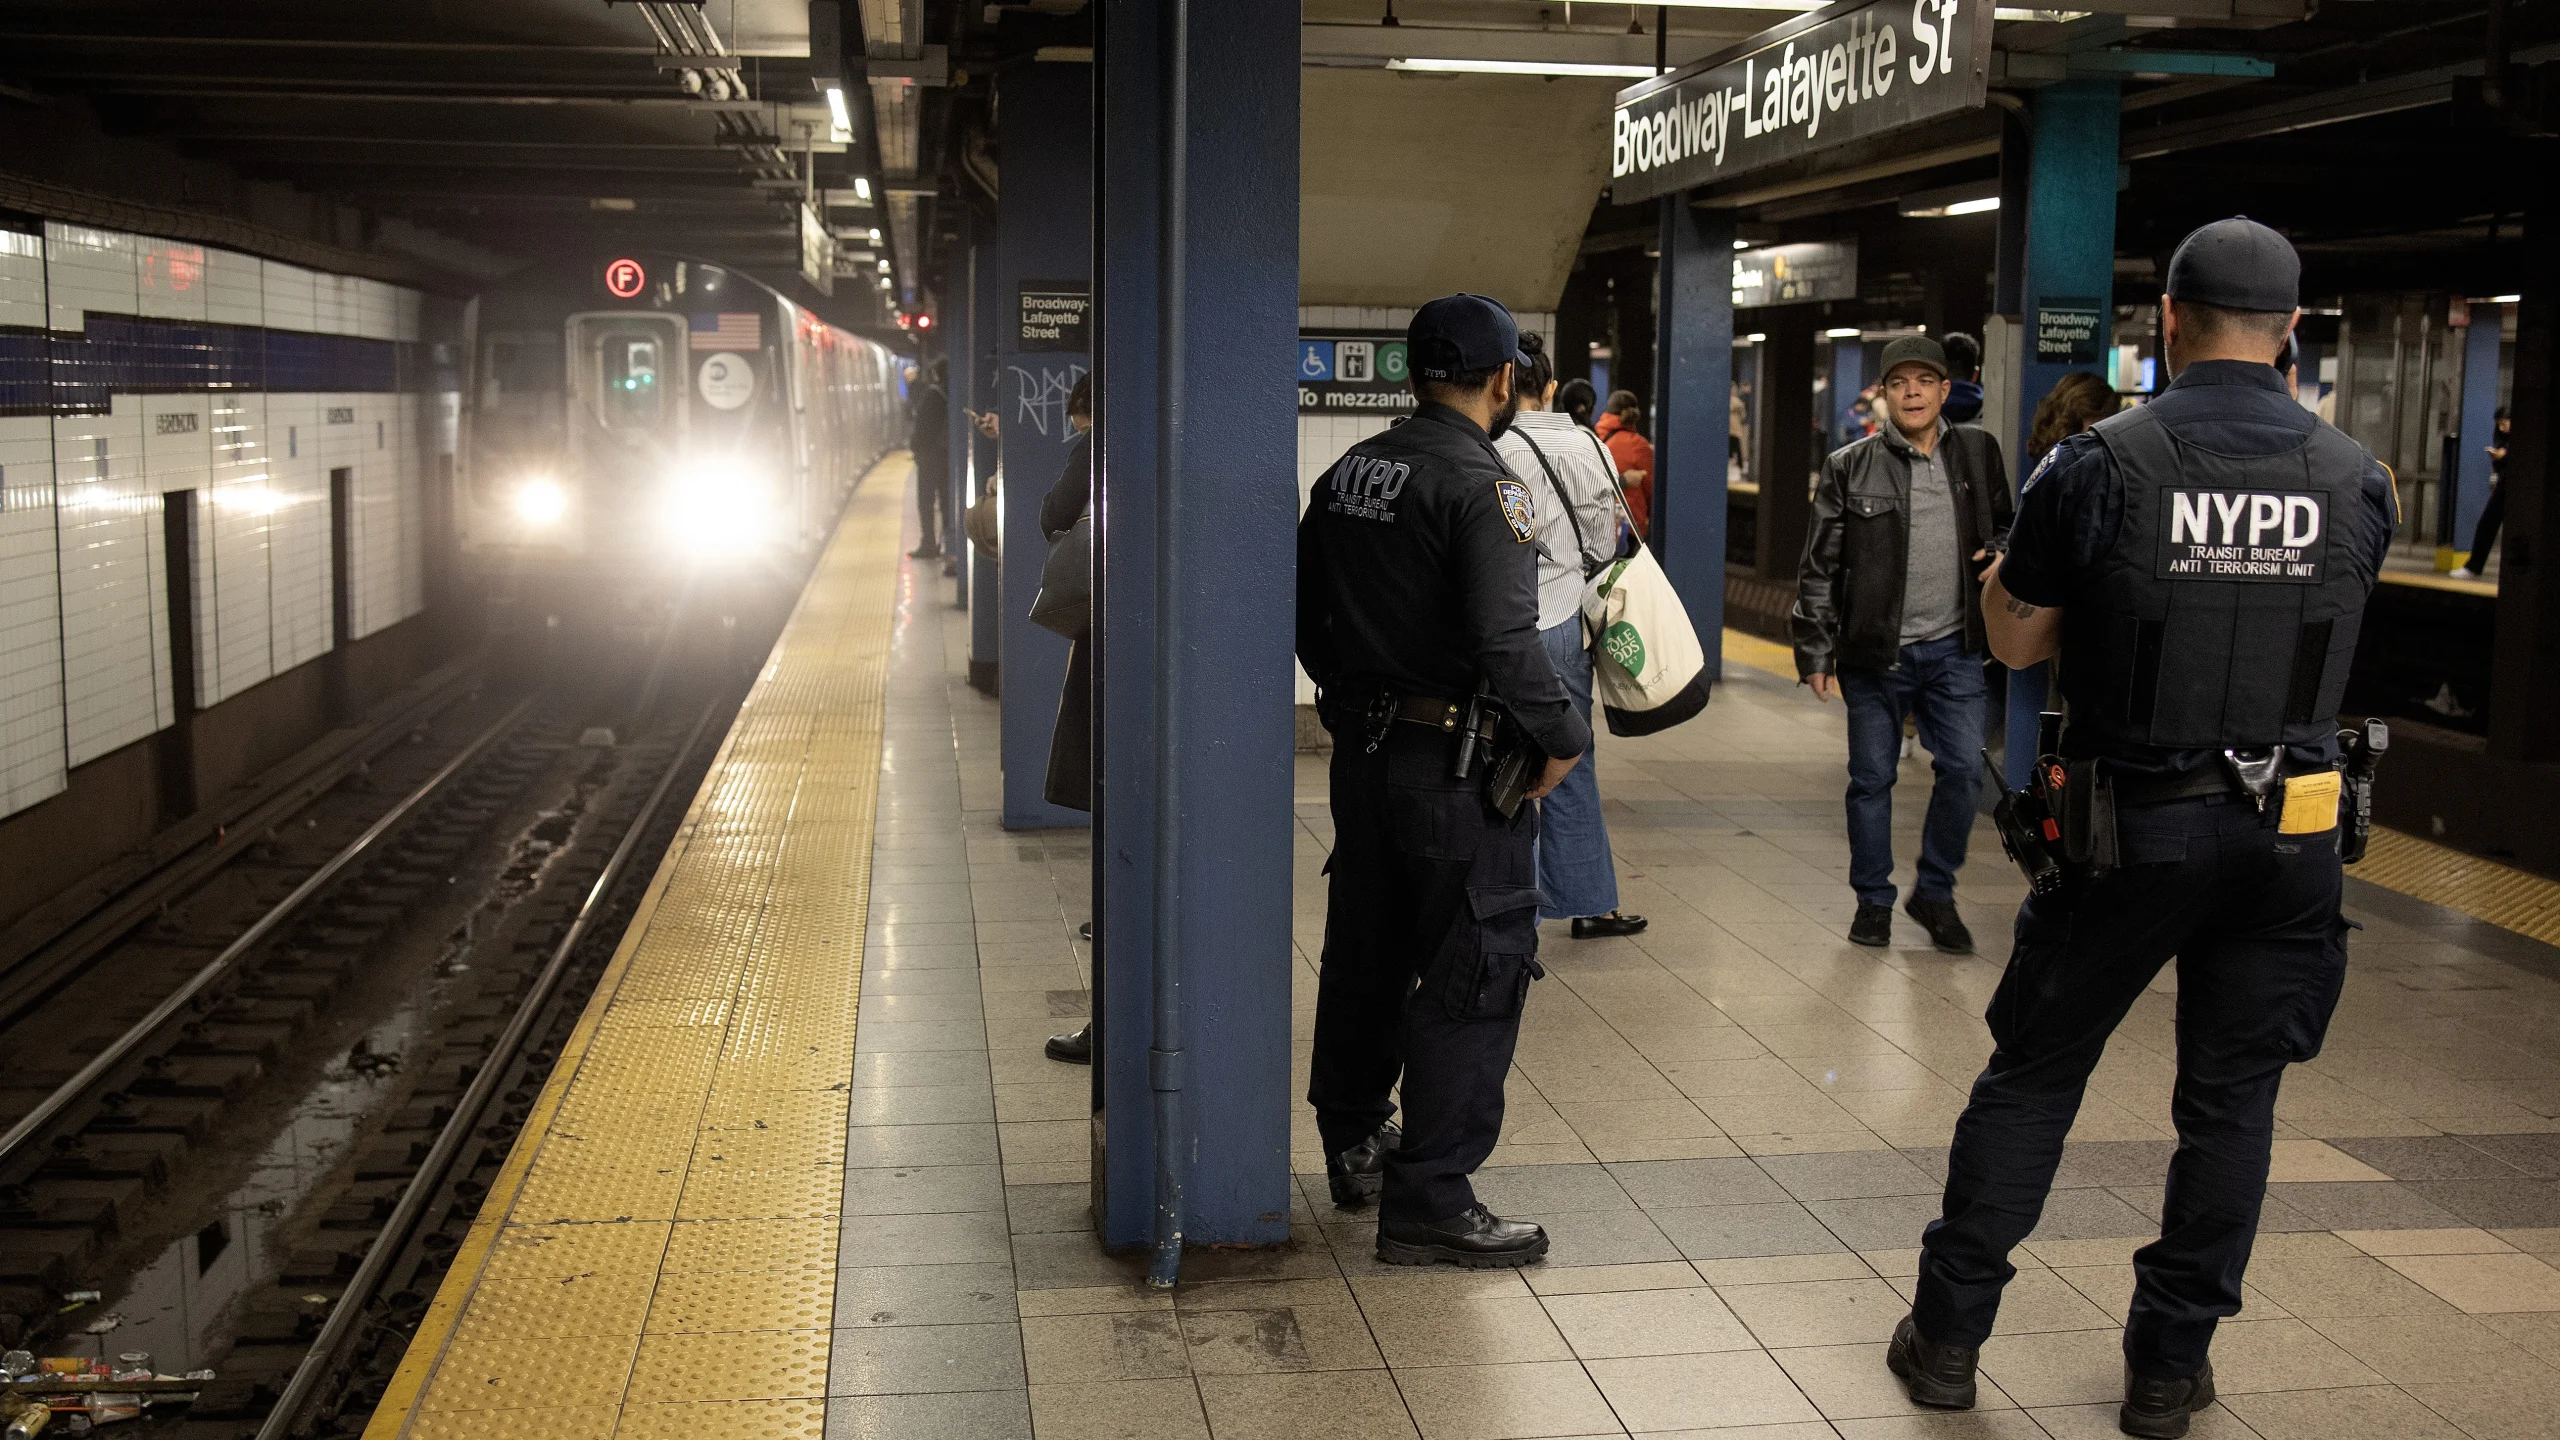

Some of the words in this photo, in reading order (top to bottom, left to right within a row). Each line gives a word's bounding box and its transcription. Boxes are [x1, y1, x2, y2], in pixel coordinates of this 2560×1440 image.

[1613, 11, 1897, 178] Broadway-Lafayette
[1909, 0, 1958, 85] St
[617, 266, 634, 290] F
[1022, 296, 1089, 312] Broadway-
[1022, 311, 1080, 326] Lafayette
[2040, 312, 2099, 329] Broadway-
[1022, 326, 1060, 339] Street
[2039, 326, 2090, 342] Lafayette
[2038, 340, 2072, 353] Street
[1386, 351, 1404, 373] 6
[1298, 387, 1318, 407] To
[1325, 389, 1418, 408] mezzanin
[1330, 455, 1410, 500] NYPD
[1337, 491, 1362, 506] TRANSIT
[1363, 496, 1389, 511] BUREAU
[1327, 501, 1341, 513] ANTI
[1344, 503, 1378, 520] TERRORISM
[1380, 511, 1395, 523] UNIT
[2171, 492, 2320, 548] NYPD
[2188, 545, 2245, 560] TRANSIT
[2250, 547, 2300, 562] BUREAU
[2169, 559, 2201, 573] ANTI
[2208, 560, 2280, 576] TERRORISM
[2286, 563, 2315, 577] UNIT
[1613, 640, 1640, 663] ODS
